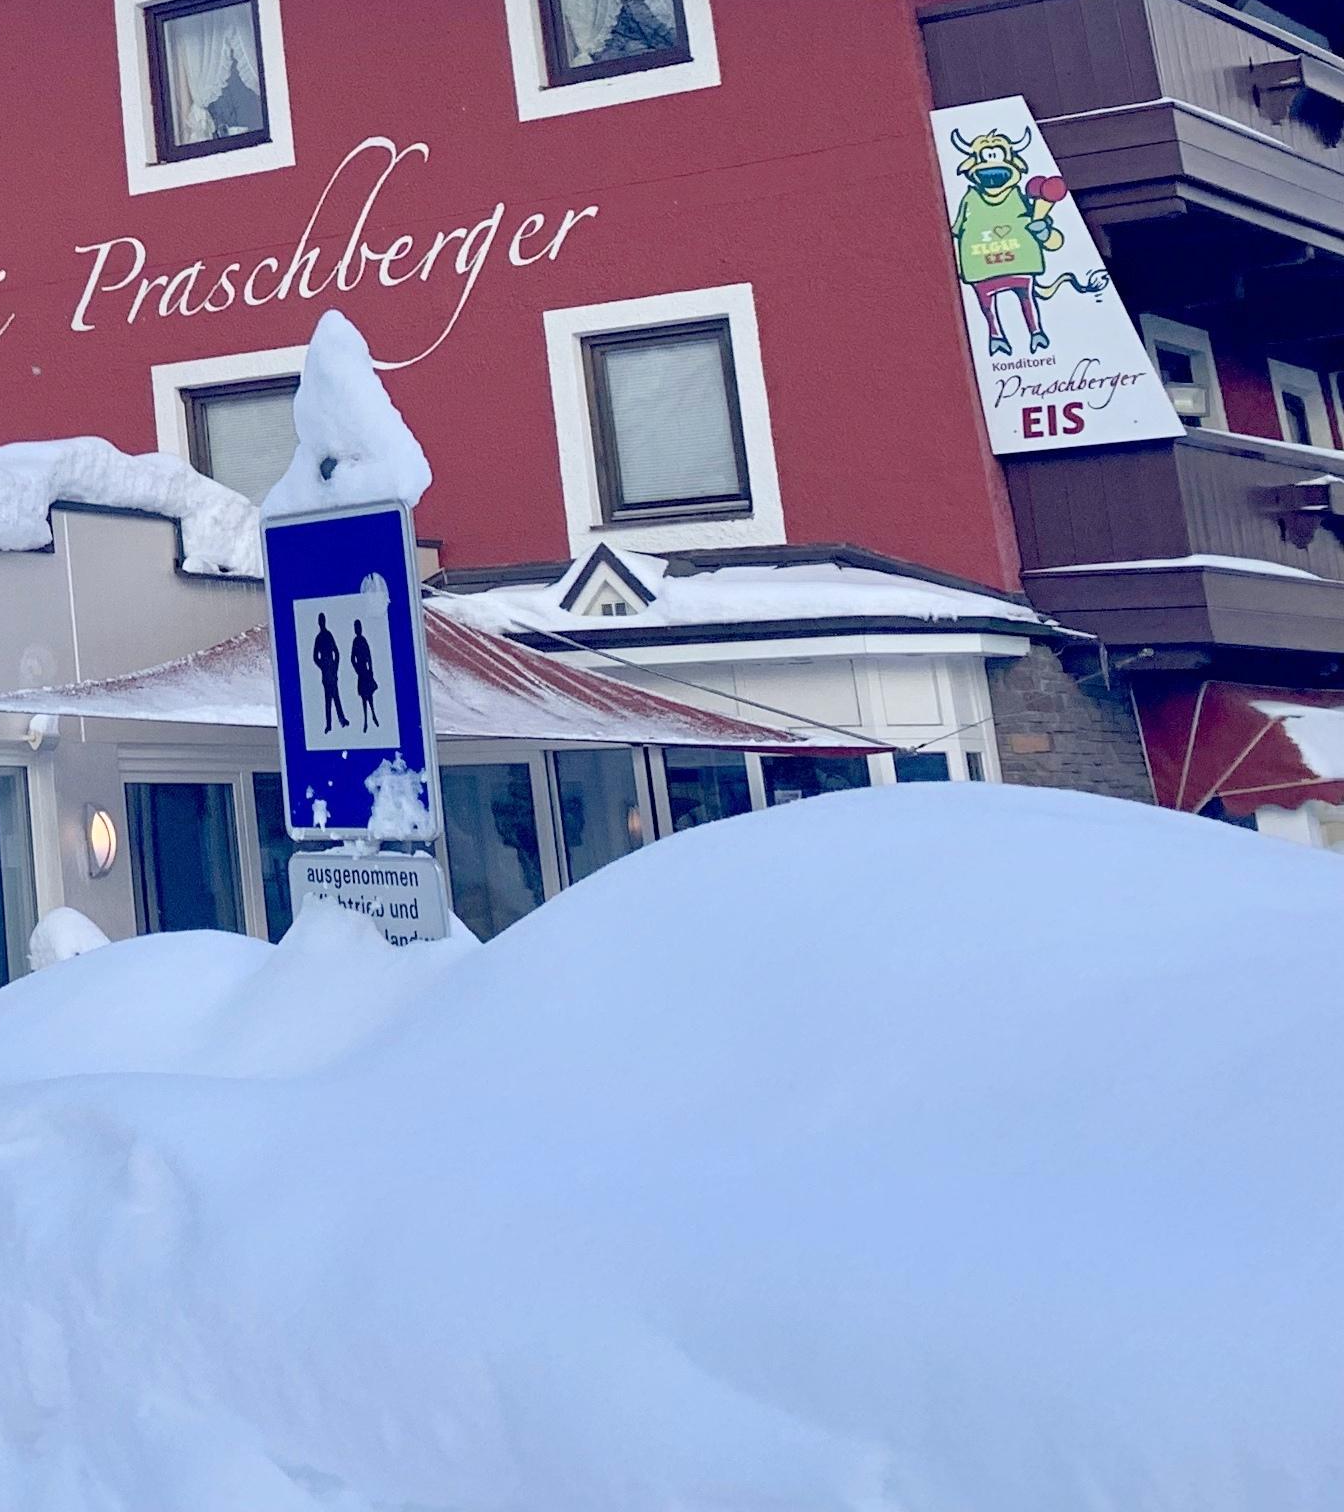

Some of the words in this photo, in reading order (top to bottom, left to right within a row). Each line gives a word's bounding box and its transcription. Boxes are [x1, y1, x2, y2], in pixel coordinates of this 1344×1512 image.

[70, 136, 599, 370] Praschberger
[984, 250, 1015, 265] EIS
[992, 355, 1057, 372] Konditorei
[994, 358, 1147, 410] Praschberger
[1021, 402, 1085, 439] EIS
[307, 867, 419, 889] ausgenommen
[390, 897, 419, 920] und
